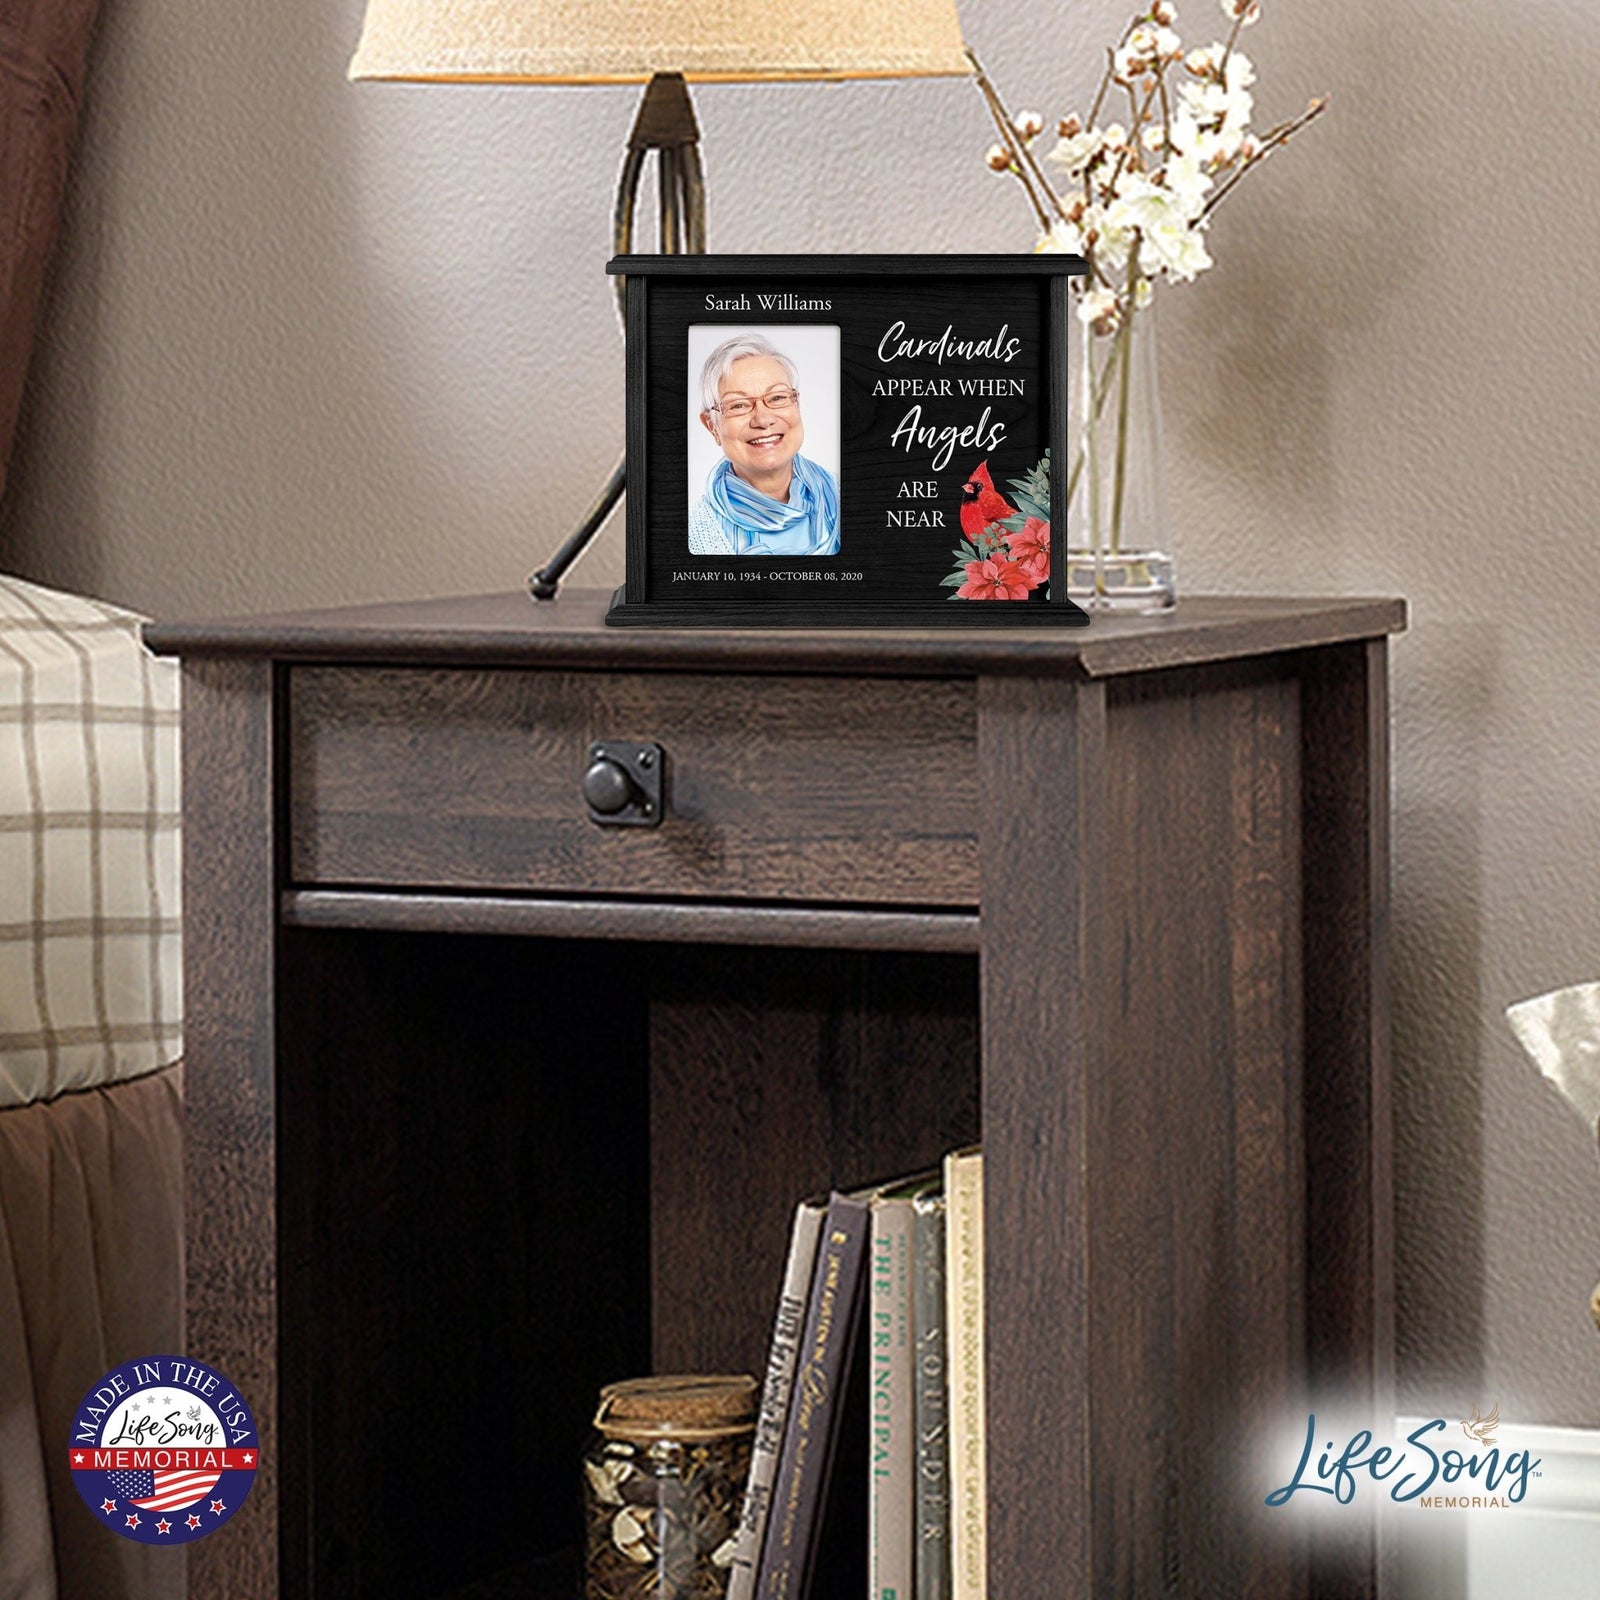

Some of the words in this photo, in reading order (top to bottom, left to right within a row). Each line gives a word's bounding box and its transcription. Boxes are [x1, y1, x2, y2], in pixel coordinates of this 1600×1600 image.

[704, 293, 751, 311] Sarah
[756, 293, 832, 311] Williams
[877, 320, 1022, 366] Cardinals
[871, 379, 954, 397] APPEAR
[957, 379, 1025, 396] WHEN
[890, 404, 1008, 471] Angels
[896, 480, 939, 498] ARE
[886, 510, 946, 528] NEAR
[671, 571, 721, 583] JANUARY
[723, 572, 737, 582] 10,
[740, 571, 761, 582] 1934
[769, 571, 823, 581] OCTOBER
[823, 572, 838, 582] 08,
[840, 572, 863, 581] 2020
[874, 1234, 891, 1297] THE
[873, 1311, 891, 1482] PRINCIPAL
